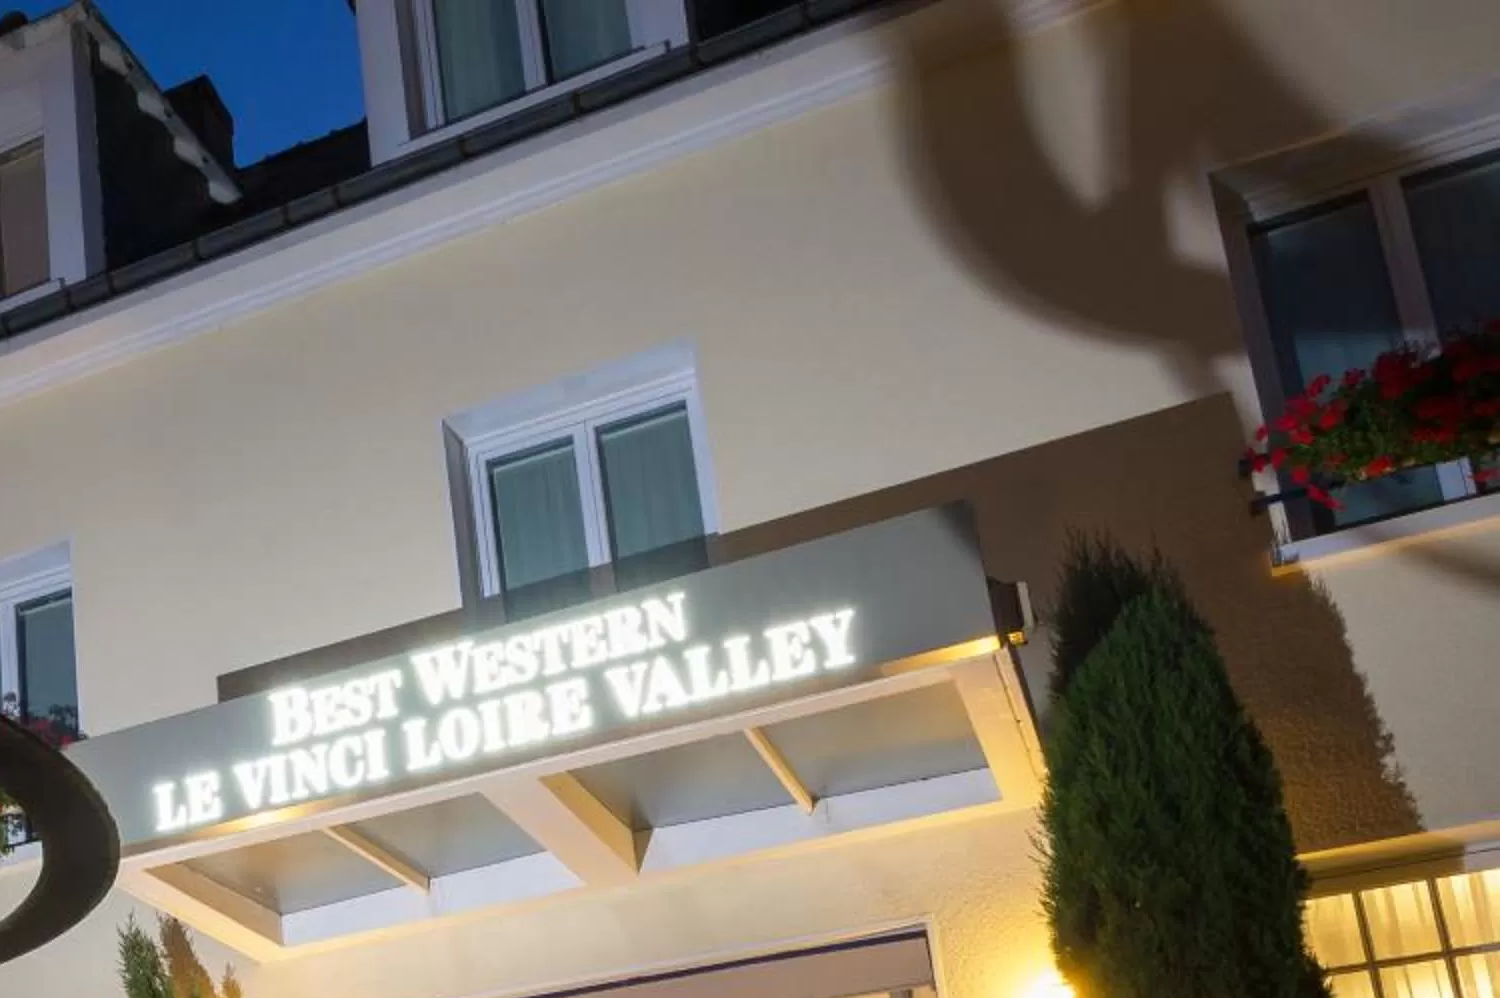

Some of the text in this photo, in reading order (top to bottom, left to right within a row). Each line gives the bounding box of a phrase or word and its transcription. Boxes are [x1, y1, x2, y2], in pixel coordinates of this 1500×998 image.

[153, 609, 857, 832] LE VINCI LOIRE VALLEY
[267, 592, 689, 746] BEST WESTERN
